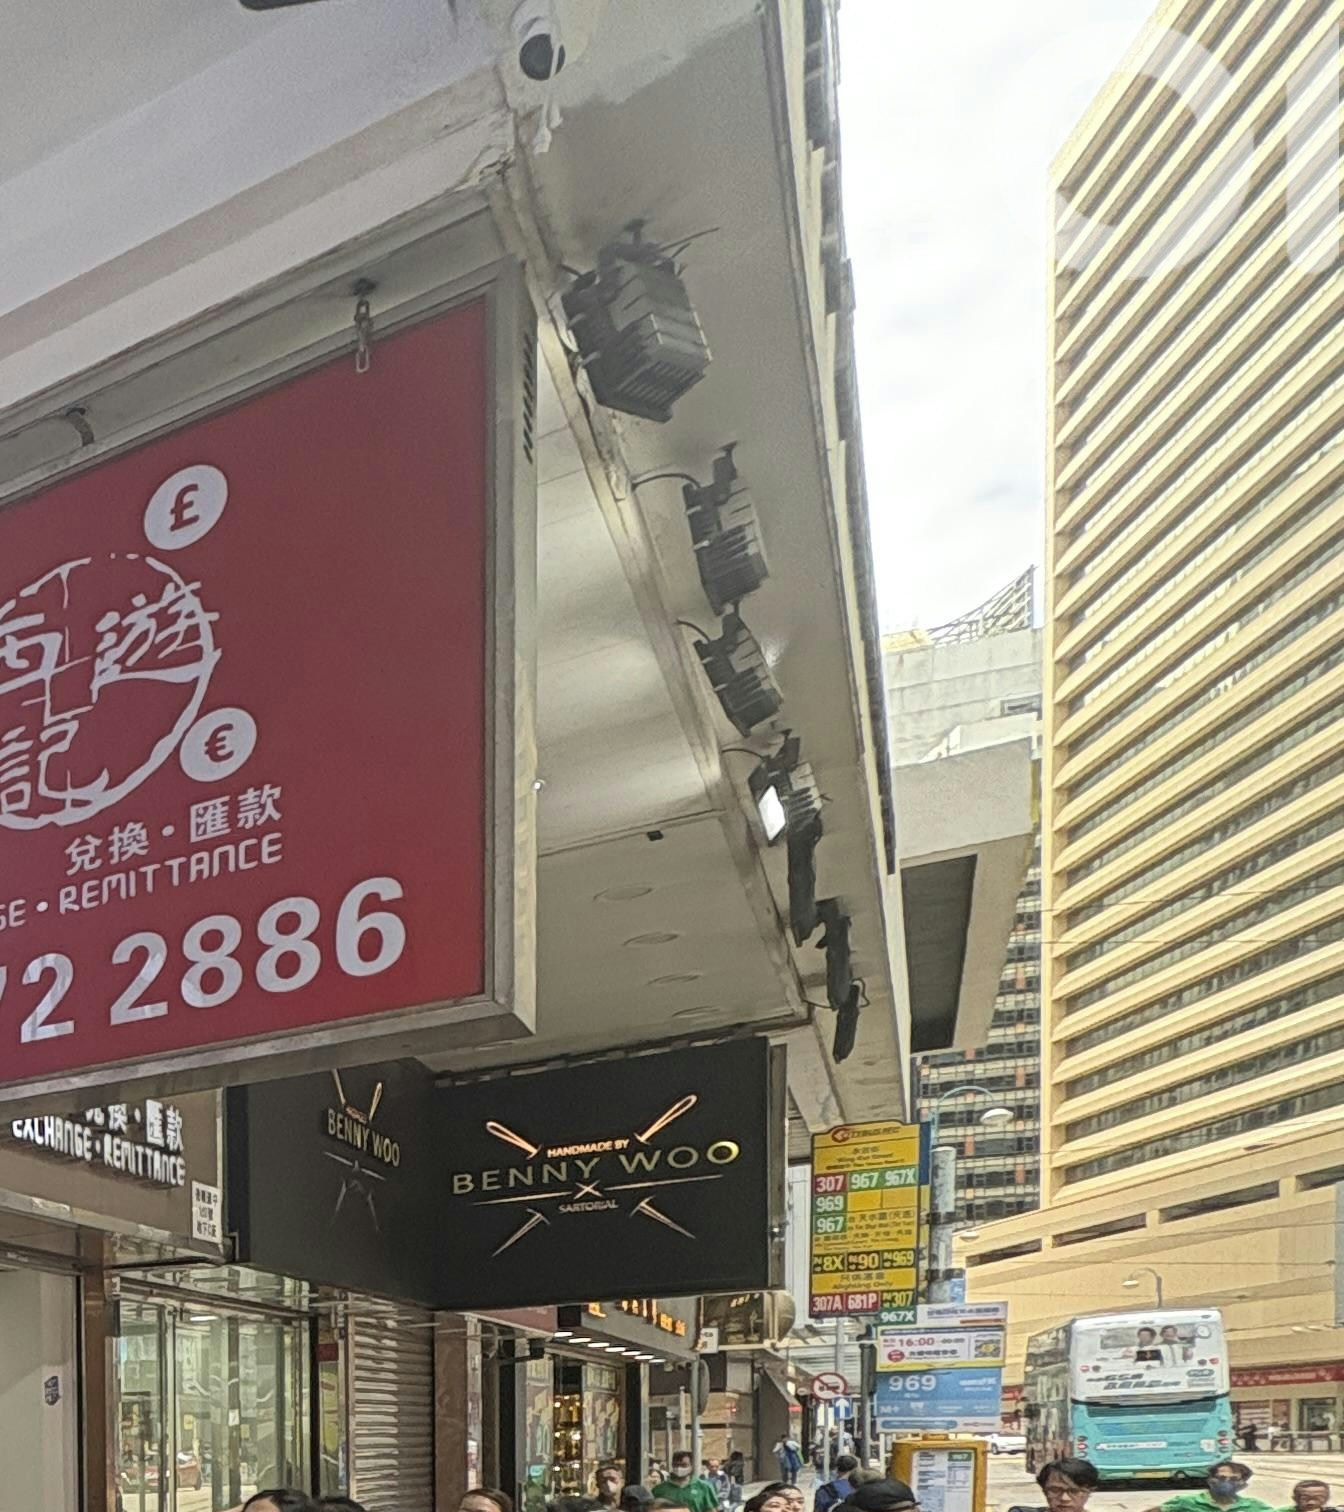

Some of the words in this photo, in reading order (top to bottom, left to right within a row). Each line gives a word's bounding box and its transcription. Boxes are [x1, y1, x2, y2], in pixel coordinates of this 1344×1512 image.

[59, 832, 284, 914] REMITTANCE
[110, 877, 408, 1027] 2886
[327, 1107, 370, 1150] BENNY
[371, 1128, 400, 1168] WOO
[103, 1133, 186, 1187] REMITTANCE
[546, 1141, 614, 1160] HANDMADE
[615, 1138, 630, 1151] BY
[452, 1157, 600, 1196] BENNY
[618, 1139, 741, 1176] WOO
[815, 1175, 844, 1193] 307
[851, 1171, 879, 1189] 967
[884, 1168, 916, 1186] 967X
[558, 1199, 619, 1214] SARTORIAL
[816, 1195, 844, 1212] 969
[816, 1216, 844, 1233] 967
[813, 1295, 843, 1312] 307A
[848, 1293, 877, 1310] 681P
[881, 1311, 914, 1323] 967X
[888, 1374, 937, 1391] 969
